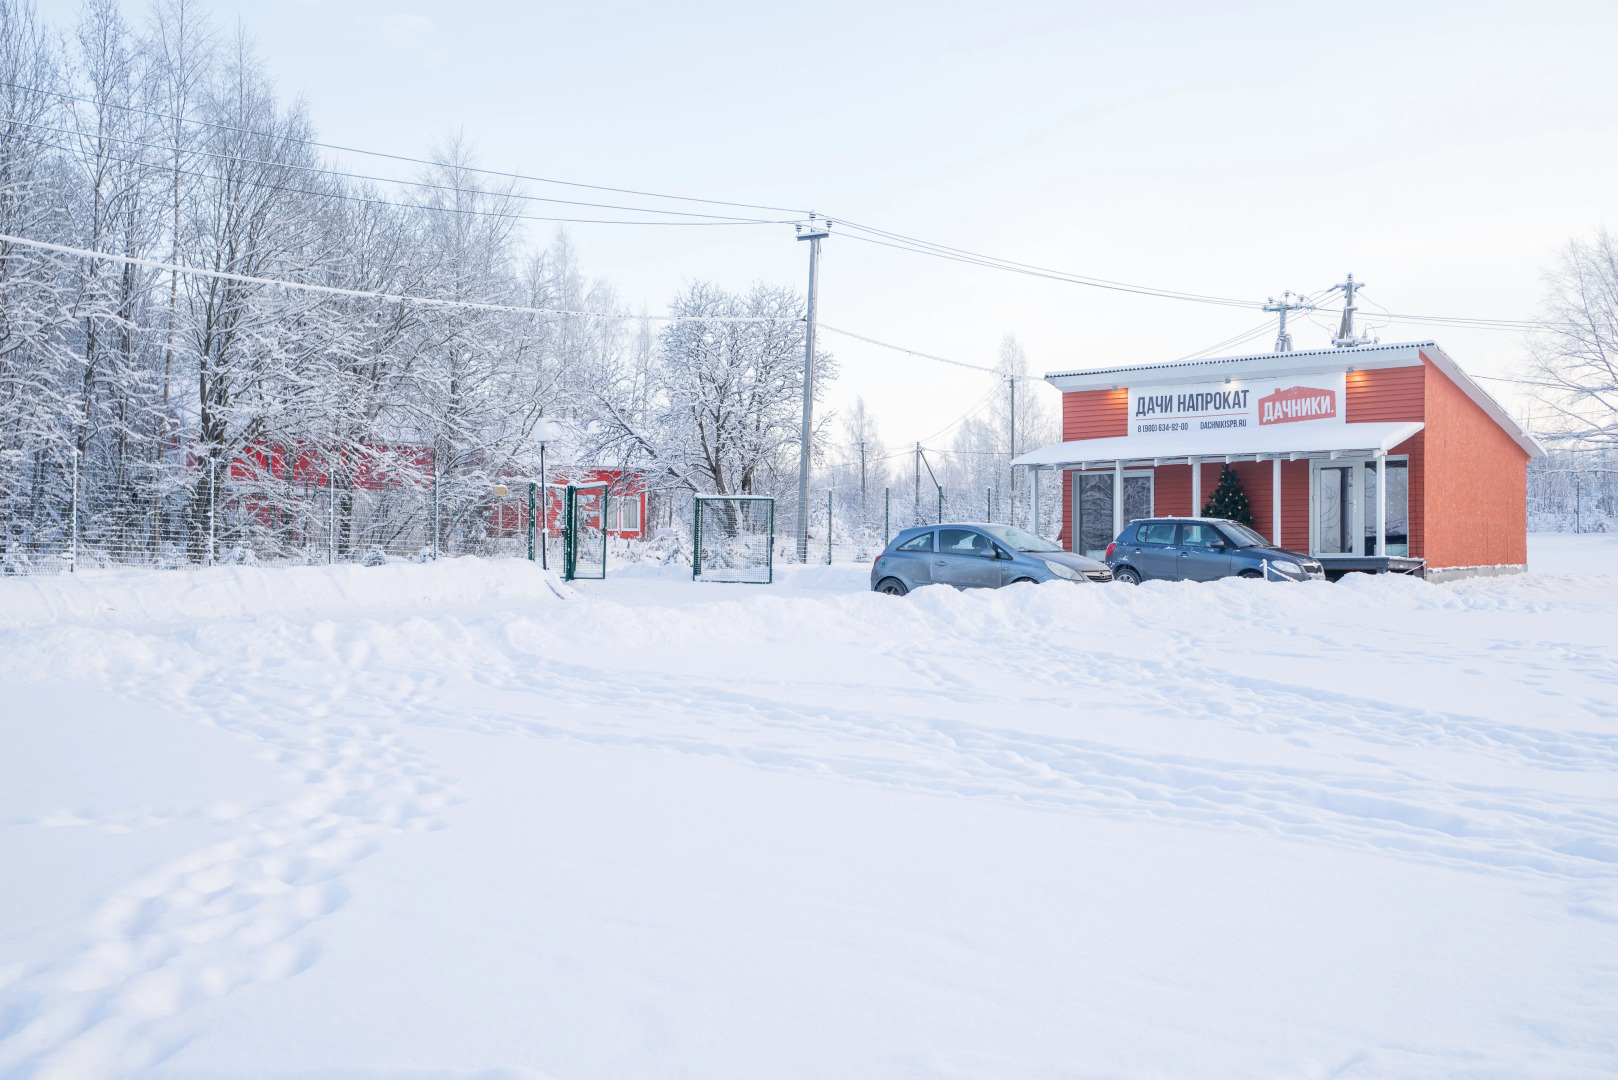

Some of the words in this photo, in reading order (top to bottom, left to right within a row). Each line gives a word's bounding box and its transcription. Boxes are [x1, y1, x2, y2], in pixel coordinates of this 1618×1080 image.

[1136, 395, 1173, 417] ДАЧИ
[1178, 390, 1249, 412] НАПРОКАТ
[1263, 396, 1334, 422] ДАЧНИКИ.
[1158, 422, 1188, 432] 634-92-00
[1200, 419, 1247, 430] DACHNIKISPB.RU
